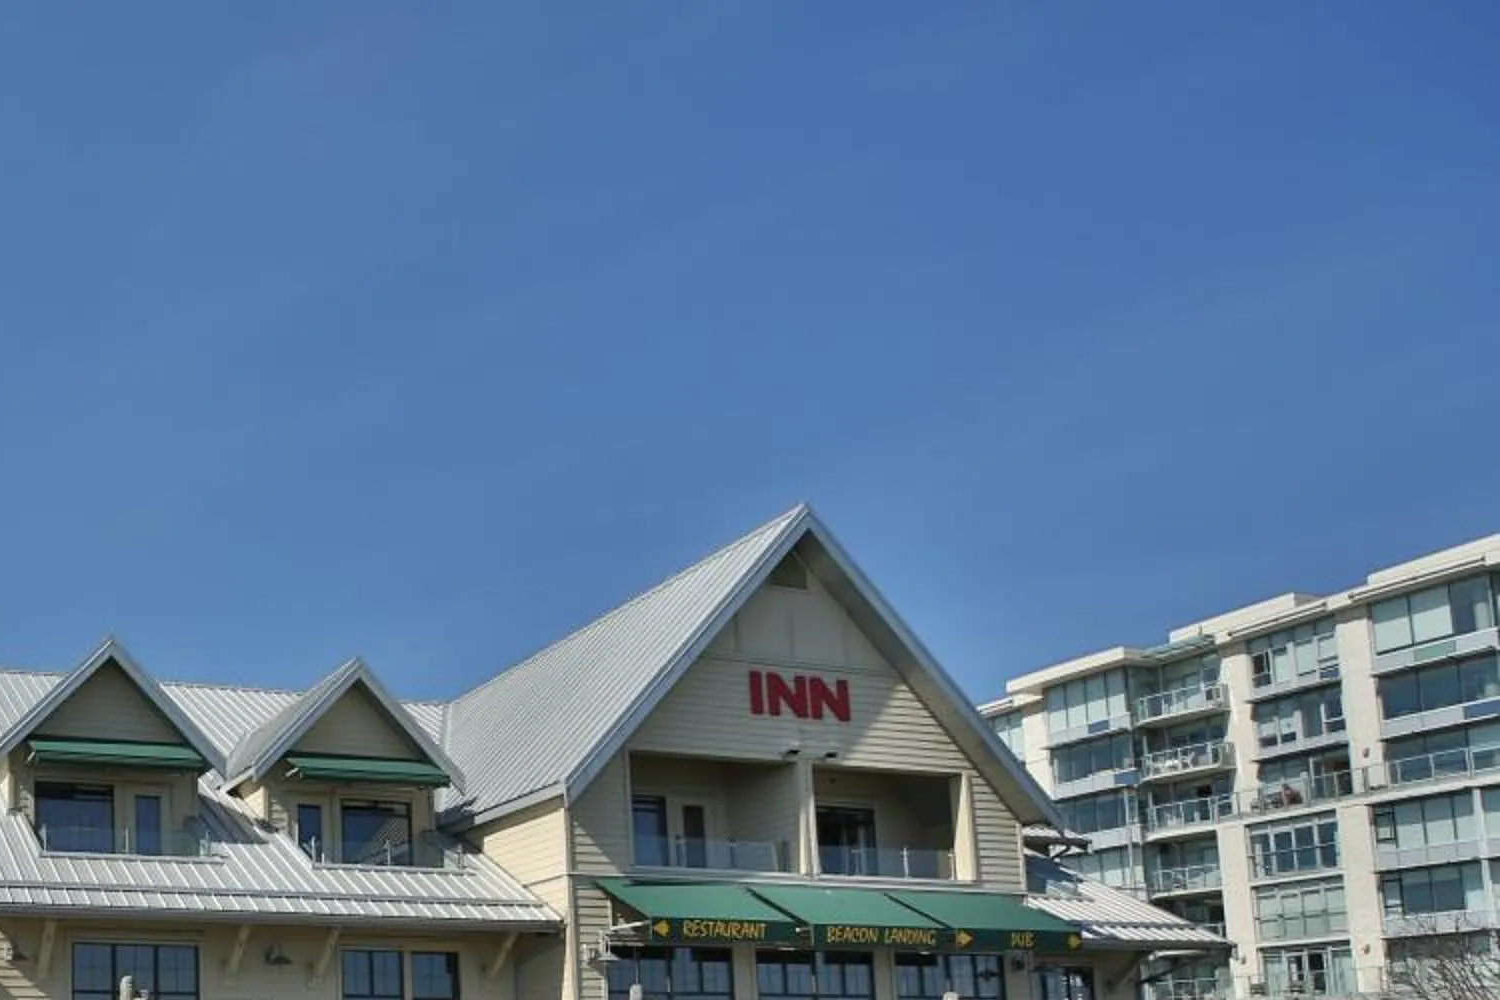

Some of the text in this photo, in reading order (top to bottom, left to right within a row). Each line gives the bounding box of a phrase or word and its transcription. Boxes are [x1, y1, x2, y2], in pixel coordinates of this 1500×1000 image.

[749, 670, 851, 722] INN
[683, 920, 766, 939] RESTAURANT
[827, 926, 936, 945] BEACON LANDING
